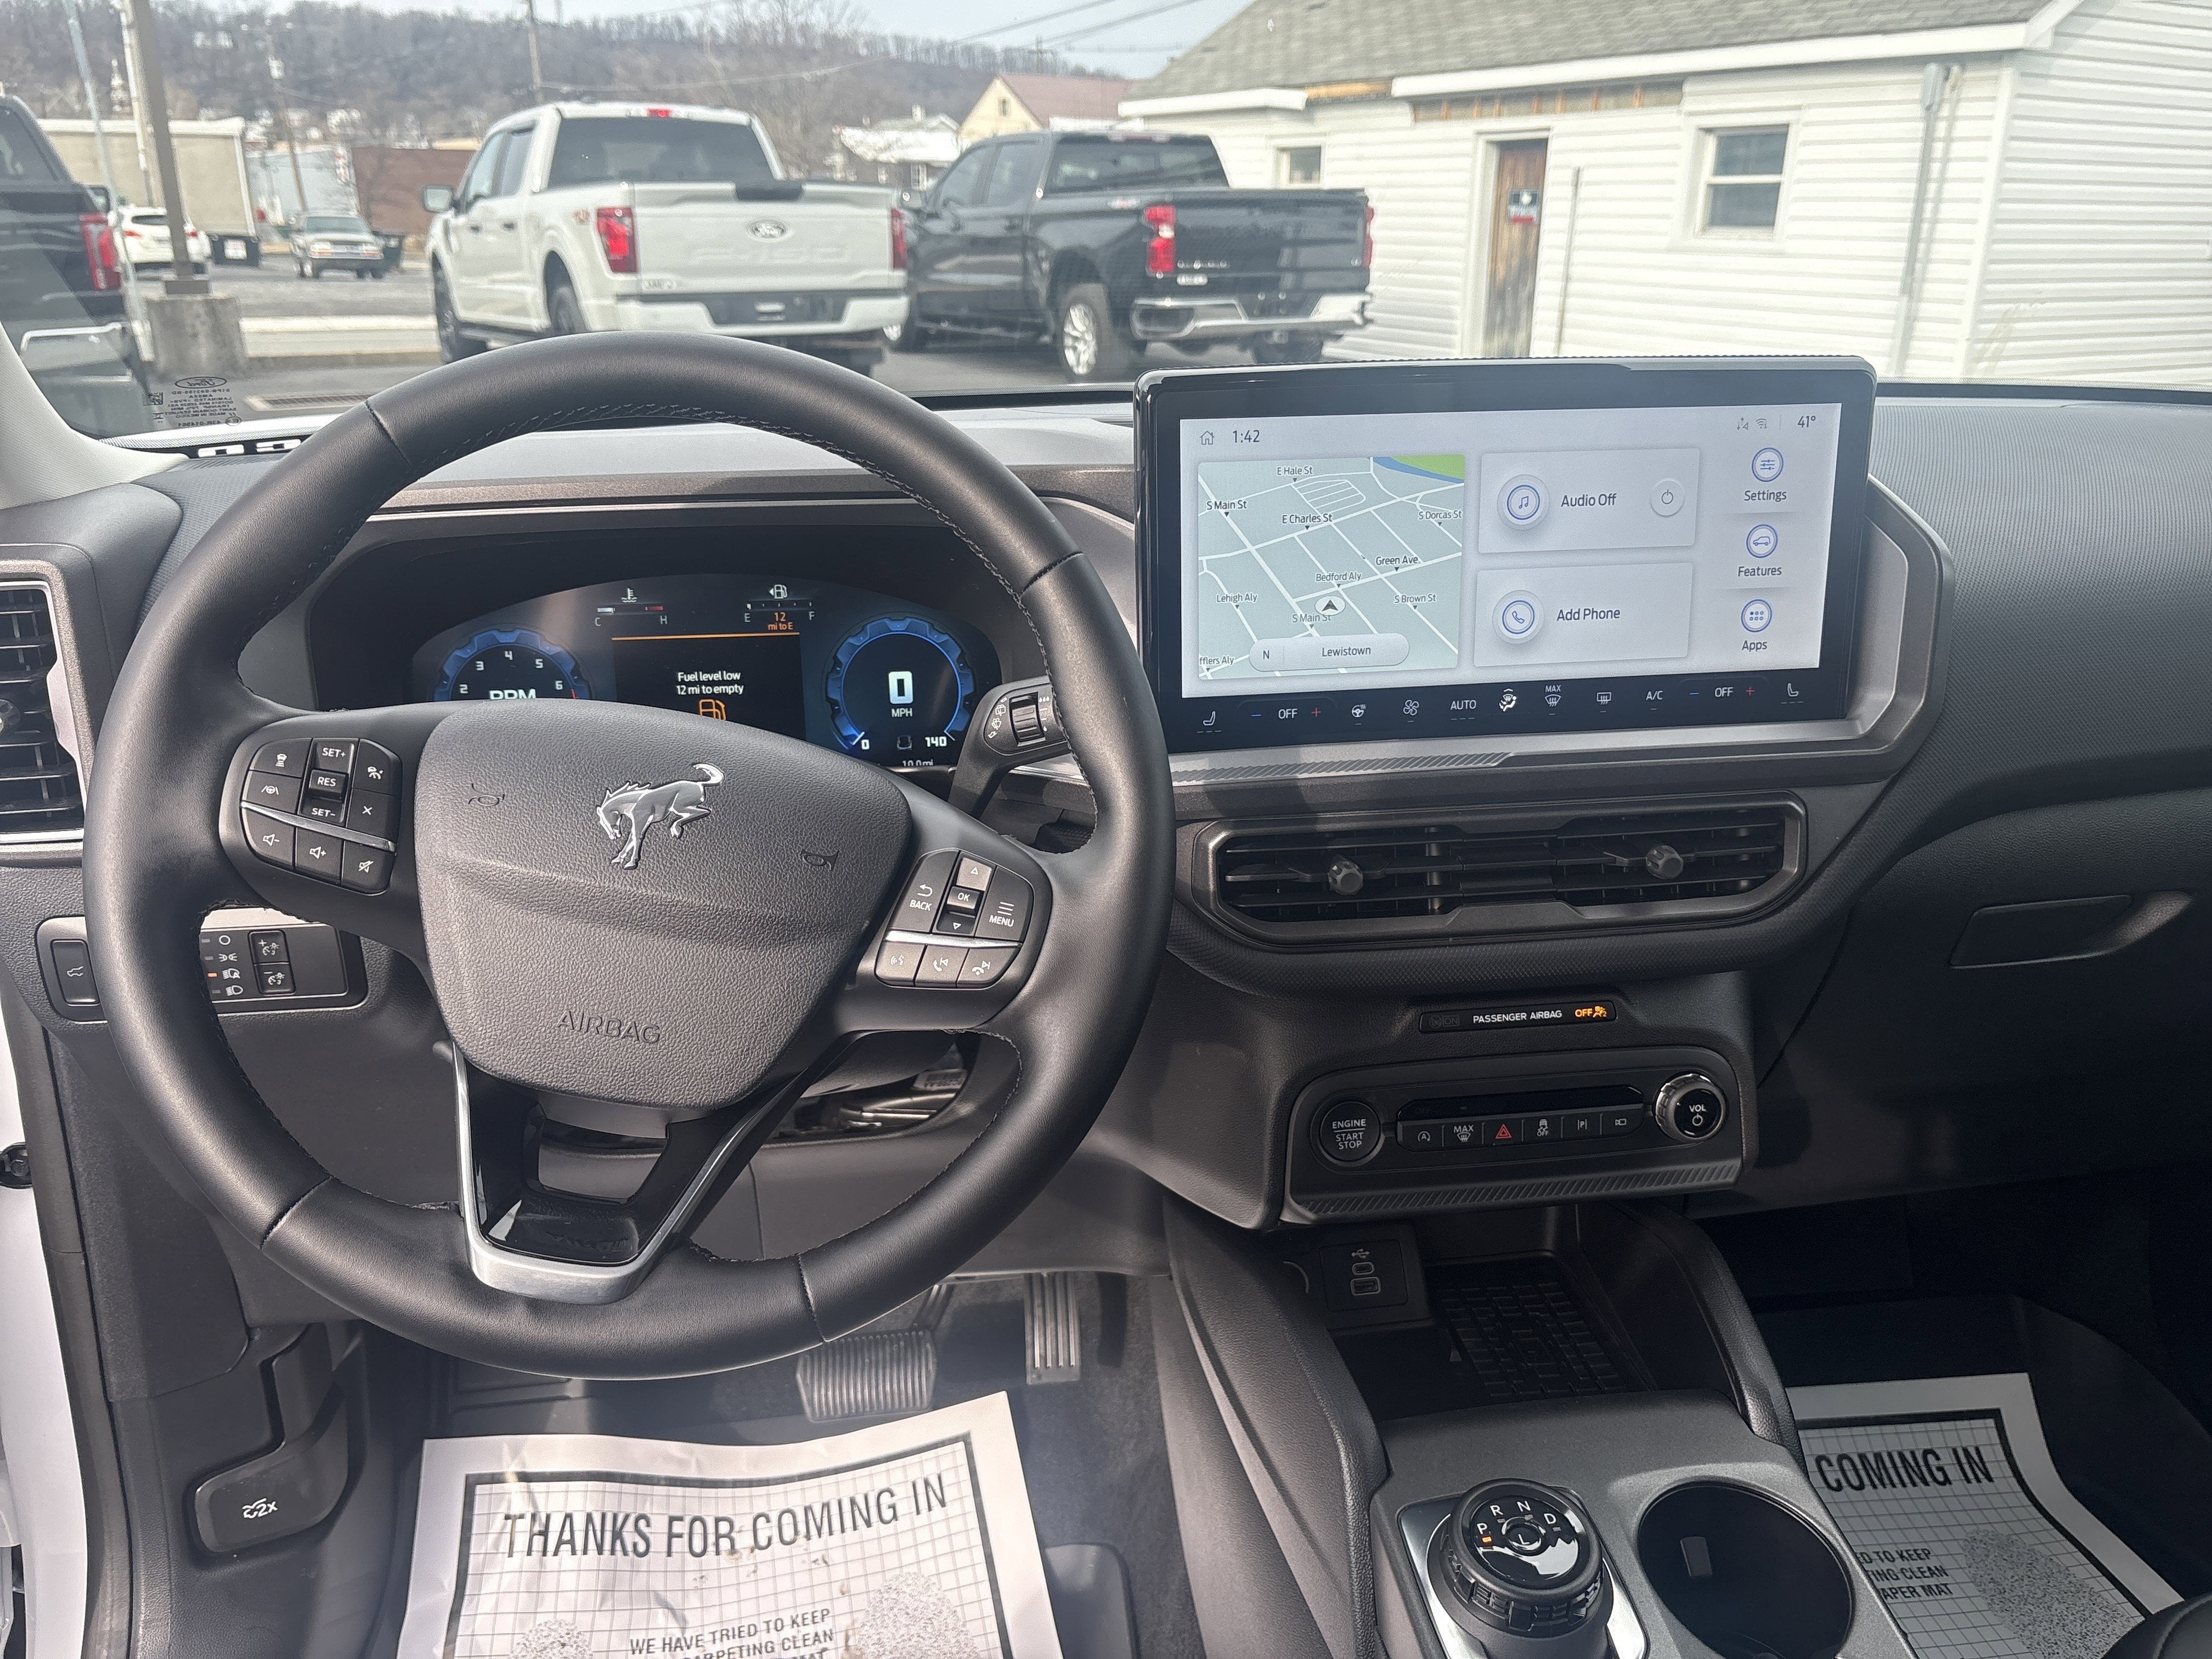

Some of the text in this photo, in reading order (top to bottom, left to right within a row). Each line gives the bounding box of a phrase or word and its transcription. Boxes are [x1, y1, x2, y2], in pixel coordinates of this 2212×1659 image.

[1797, 415, 1816, 428] 41°
[1232, 430, 1260, 443] 1:42
[1277, 466, 1313, 476] E Hale St
[1561, 493, 1617, 507] Audio Off
[1743, 489, 1787, 503] Settings
[1206, 500, 1247, 510] S Main St
[1282, 513, 1332, 524] E Charles St
[1418, 510, 1462, 520] S Dorcas St
[1376, 555, 1418, 566] Green Ave
[1316, 572, 1362, 582] Bedford Aly
[1737, 566, 1782, 577] Features
[1217, 593, 1257, 604] Lehigh Aly
[1395, 593, 1436, 603] S Brown St
[744, 611, 815, 623] E 12 F
[1292, 614, 1298, 623] S
[1300, 613, 1320, 622] Main
[1556, 607, 1621, 622] Add Phone
[595, 615, 668, 627] C H
[768, 622, 778, 630] mi
[1741, 640, 1767, 652] Apps
[505, 651, 513, 661] 4
[1262, 646, 1371, 659] N Lewistown
[476, 661, 484, 671] 3
[535, 659, 544, 669] 5
[1221, 656, 1234, 665] Aly
[678, 670, 741, 682] Fuel level low
[459, 684, 469, 695] 2
[555, 680, 563, 690] 6
[676, 684, 744, 695] 12 mi to empty
[888, 671, 913, 704] 0
[1278, 687, 1733, 719] OFF AUTO A/C OFF
[891, 708, 913, 718] MPH
[861, 739, 870, 750] 0
[924, 736, 947, 747] 140
[322, 747, 346, 758] SET+
[317, 777, 337, 787] RES
[957, 892, 970, 902] OK
[909, 899, 932, 911] BACK
[989, 915, 1014, 927] MENU
[1473, 1012, 1527, 1024] PASSENGER
[1530, 1009, 1562, 1020] AIRBAG
[1574, 1008, 1593, 1018] OFF
[556, 1010, 660, 1043] AIRBAG
[1689, 1104, 1706, 1113] VOL
[1332, 1118, 1367, 1129] ENGINE
[1453, 1125, 1474, 1133] MAX
[1335, 1132, 1364, 1142] START
[1537, 1129, 1549, 1137] OFF
[1338, 1140, 1362, 1150] STOP
[1815, 1446, 1994, 1492] COMING IN
[1489, 1505, 1503, 1516] R
[1516, 1500, 1531, 1513] N
[504, 1473, 946, 1558] THANKS FOR COMING IN
[1543, 1513, 1556, 1524] D
[1477, 1522, 1488, 1534] P
[1518, 1534, 1530, 1545] L
[1871, 1550, 1895, 1564] TO
[1895, 1548, 1931, 1562] KEEP
[1900, 1565, 1949, 1580] CLEAN
[1921, 1583, 1953, 1597] MAT
[630, 1607, 831, 1655] WE HAVE TRIED TO KEEP
[781, 1628, 833, 1652] CLEAN
